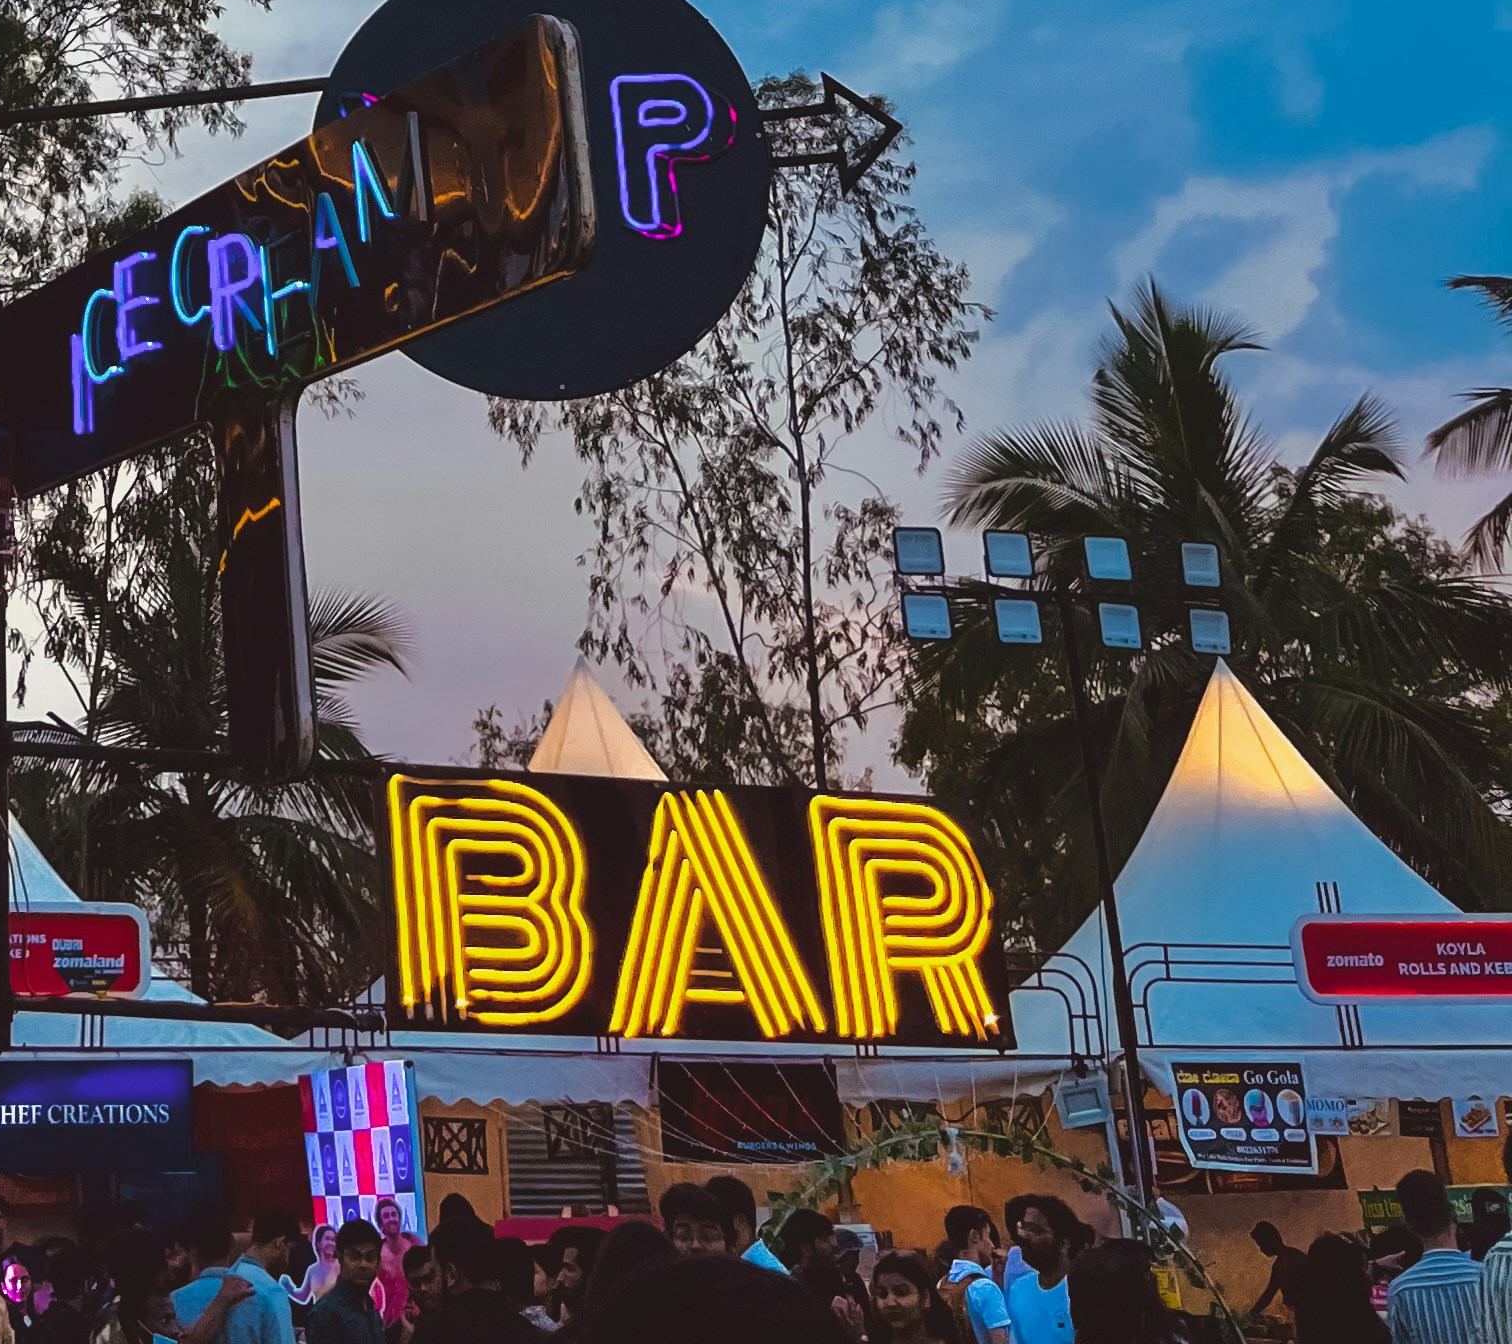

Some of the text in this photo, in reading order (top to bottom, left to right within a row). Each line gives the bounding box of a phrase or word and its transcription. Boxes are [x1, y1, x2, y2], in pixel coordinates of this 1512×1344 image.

[388, 773, 999, 1041] BAR
[1436, 943, 1487, 956] KOYLA
[53, 953, 125, 968] zomaland
[1326, 952, 1385, 968] zomato
[1398, 962, 1447, 976] ROLLS
[1450, 962, 1481, 976] AND
[1243, 1070, 1264, 1085] Go
[1267, 1070, 1300, 1085] Gola
[1305, 1099, 1345, 1112] MOMO
[47, 1104, 170, 1125] CREATIONS
